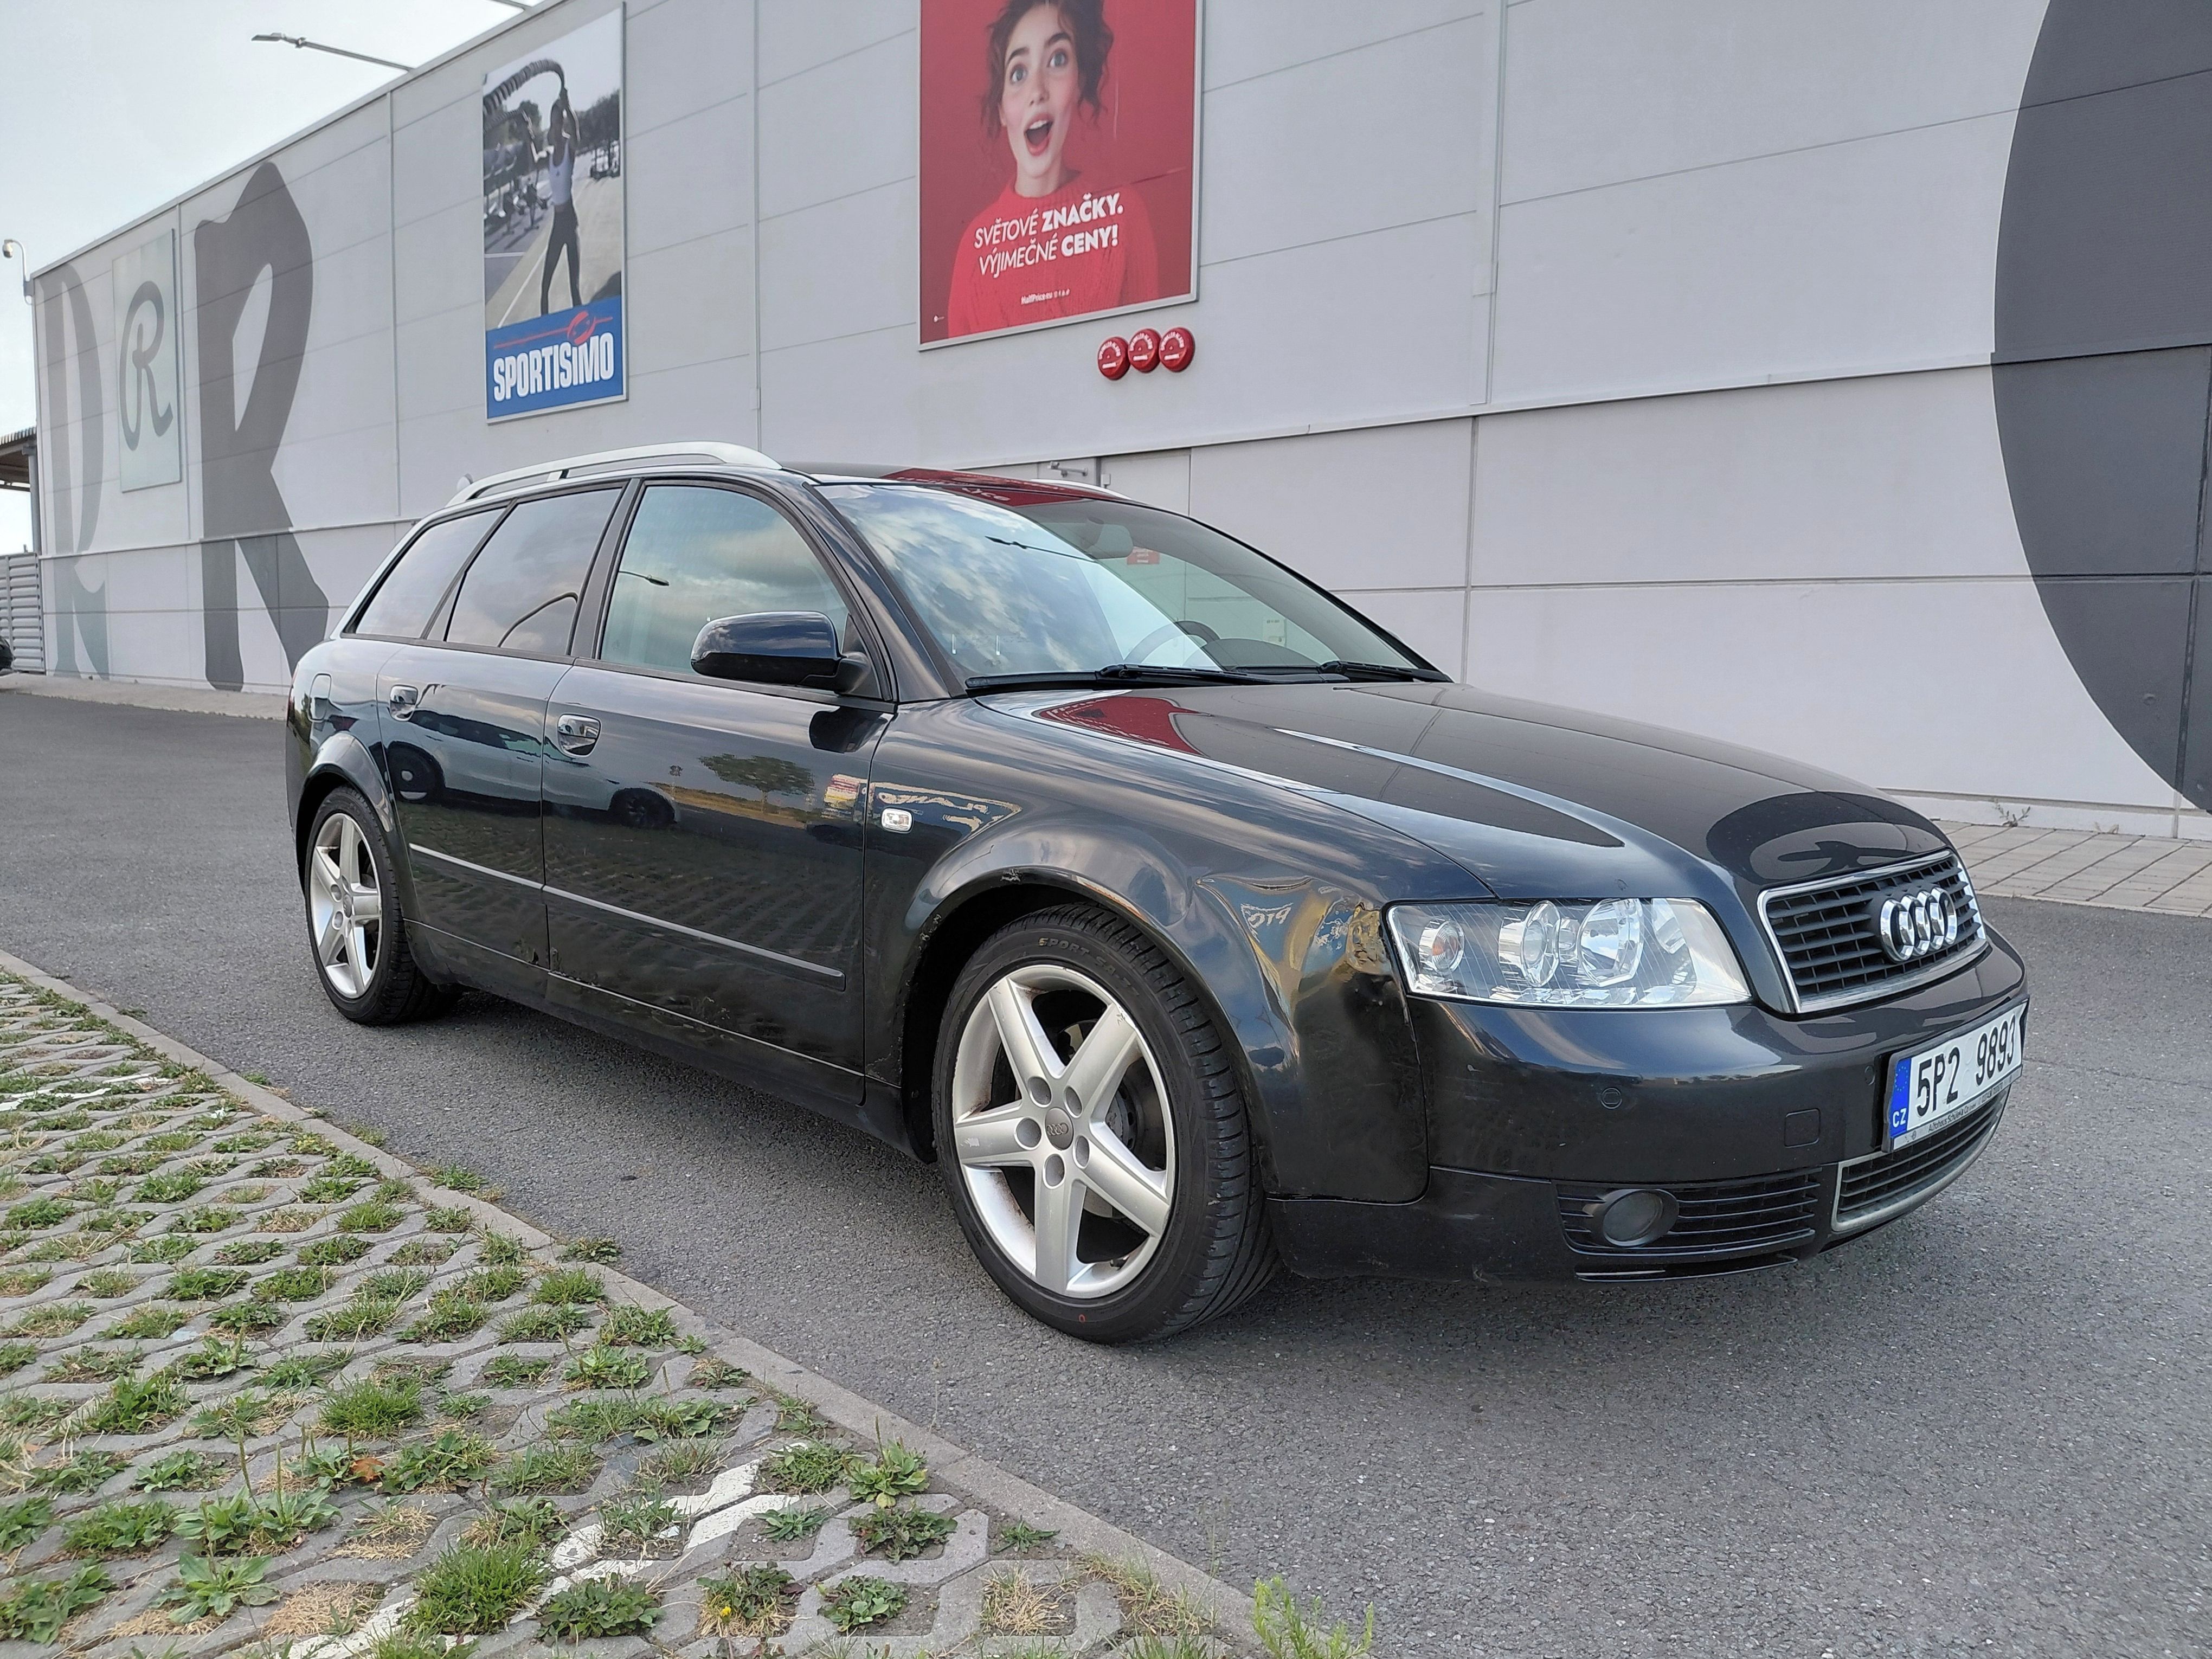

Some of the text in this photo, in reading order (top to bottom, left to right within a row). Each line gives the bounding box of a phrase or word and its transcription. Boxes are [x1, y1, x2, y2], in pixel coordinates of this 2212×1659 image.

[974, 192, 1124, 249] SVĚTOVÉ ZNAČKY.
[979, 224, 1119, 279] VÝJIMEČNÉ CENY!
[493, 331, 615, 402] SPORTISIMO
[1038, 937, 1090, 956] SPORT
[1916, 1014, 2016, 1117] 5P2 9893
[1892, 1108, 1907, 1127] CZ
